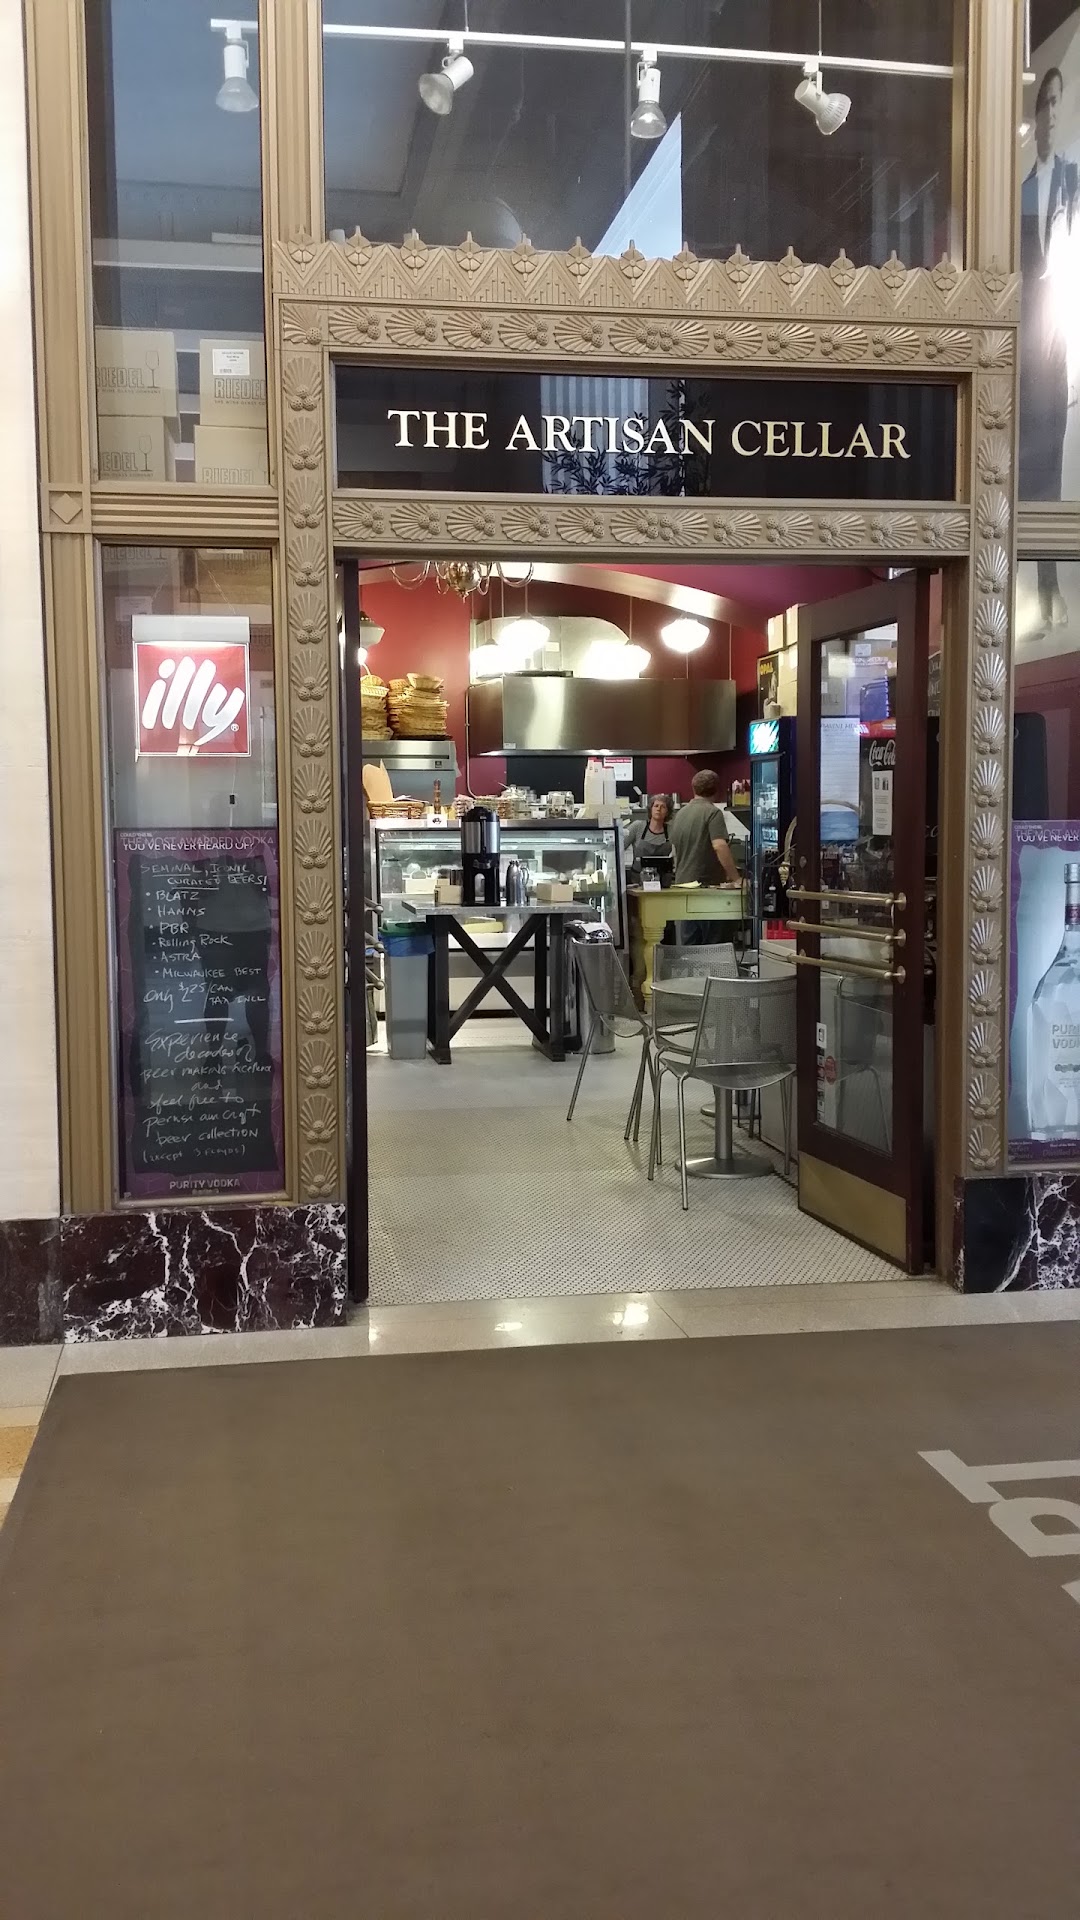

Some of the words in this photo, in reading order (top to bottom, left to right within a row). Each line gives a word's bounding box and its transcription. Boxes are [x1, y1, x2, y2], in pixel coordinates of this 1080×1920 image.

[387, 409, 490, 449] THE
[505, 414, 716, 456] ARTISAN
[731, 419, 911, 459] CELLAR
[142, 656, 245, 746] illy
[124, 843, 161, 851] YOUVE
[162, 843, 197, 851] NEVER
[156, 891, 200, 902] BLATZ
[159, 921, 190, 935] PBR
[158, 936, 197, 953] Rolling
[199, 933, 234, 948] Rock
[160, 951, 202, 963] ASTRA
[234, 967, 262, 977] BEST
[209, 997, 229, 1006] TAX
[218, 1091, 244, 1103] to
[169, 1179, 206, 1190] PURITY
[206, 1178, 241, 1189] VODKA
